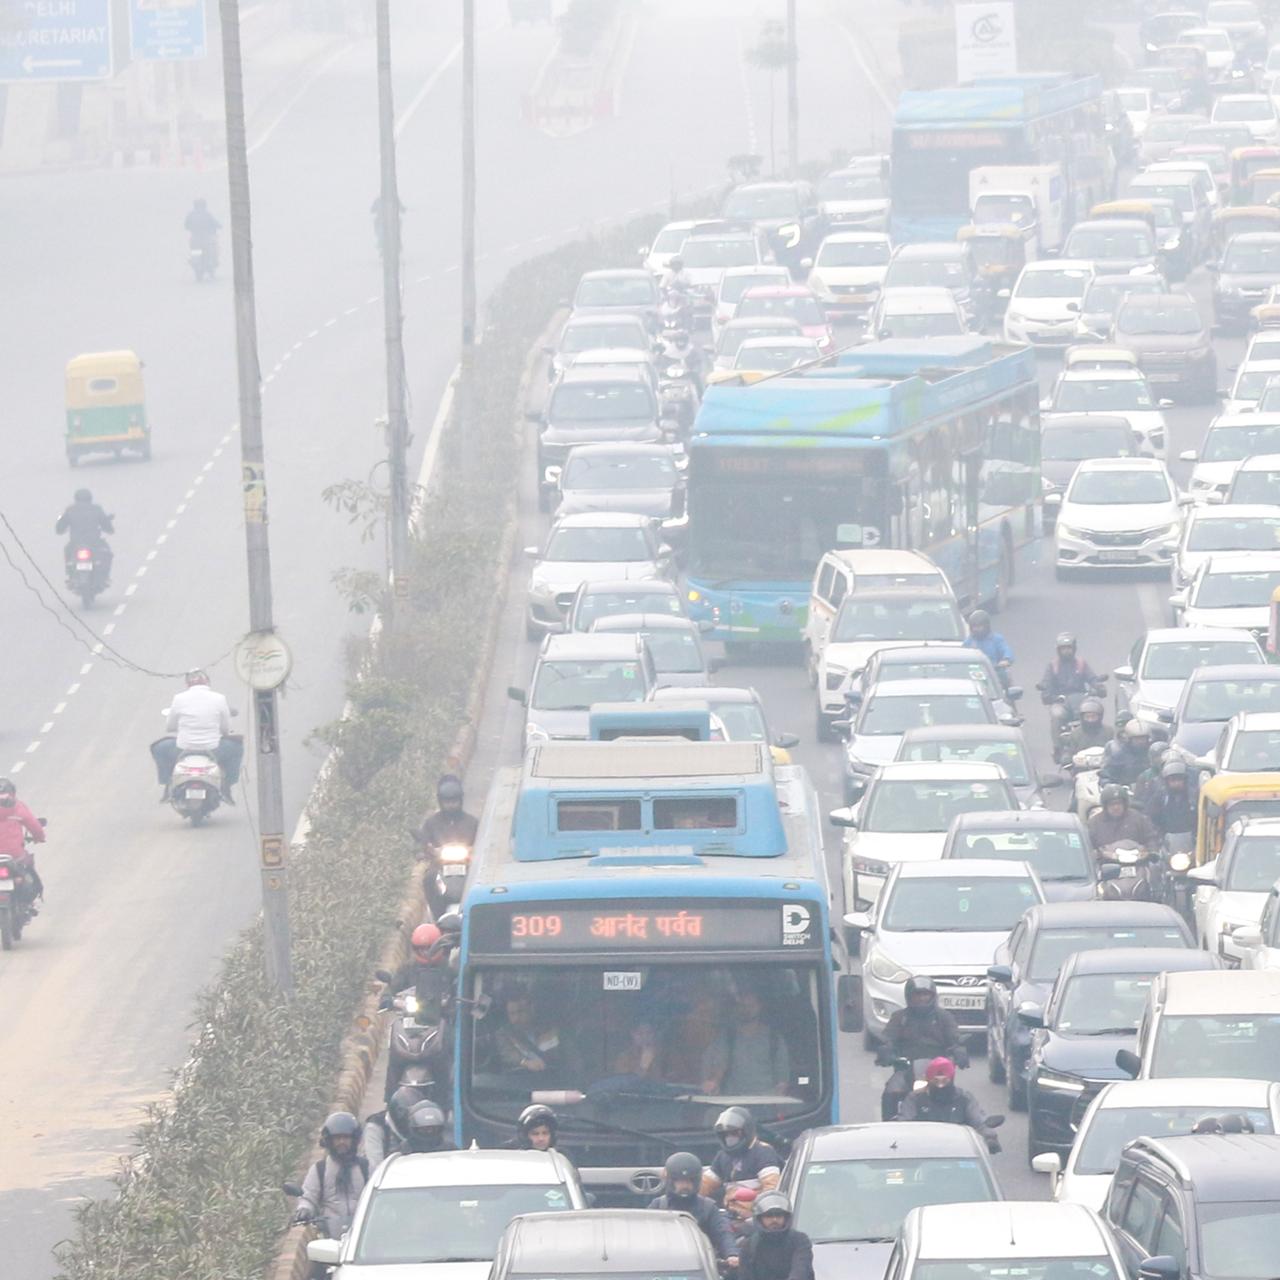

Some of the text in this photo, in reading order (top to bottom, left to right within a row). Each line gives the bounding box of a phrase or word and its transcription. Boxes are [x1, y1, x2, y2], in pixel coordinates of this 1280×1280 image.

[512, 915, 562, 936] 309
[590, 914, 649, 938] आनंद
[607, 975, 638, 988] ND-(W)
